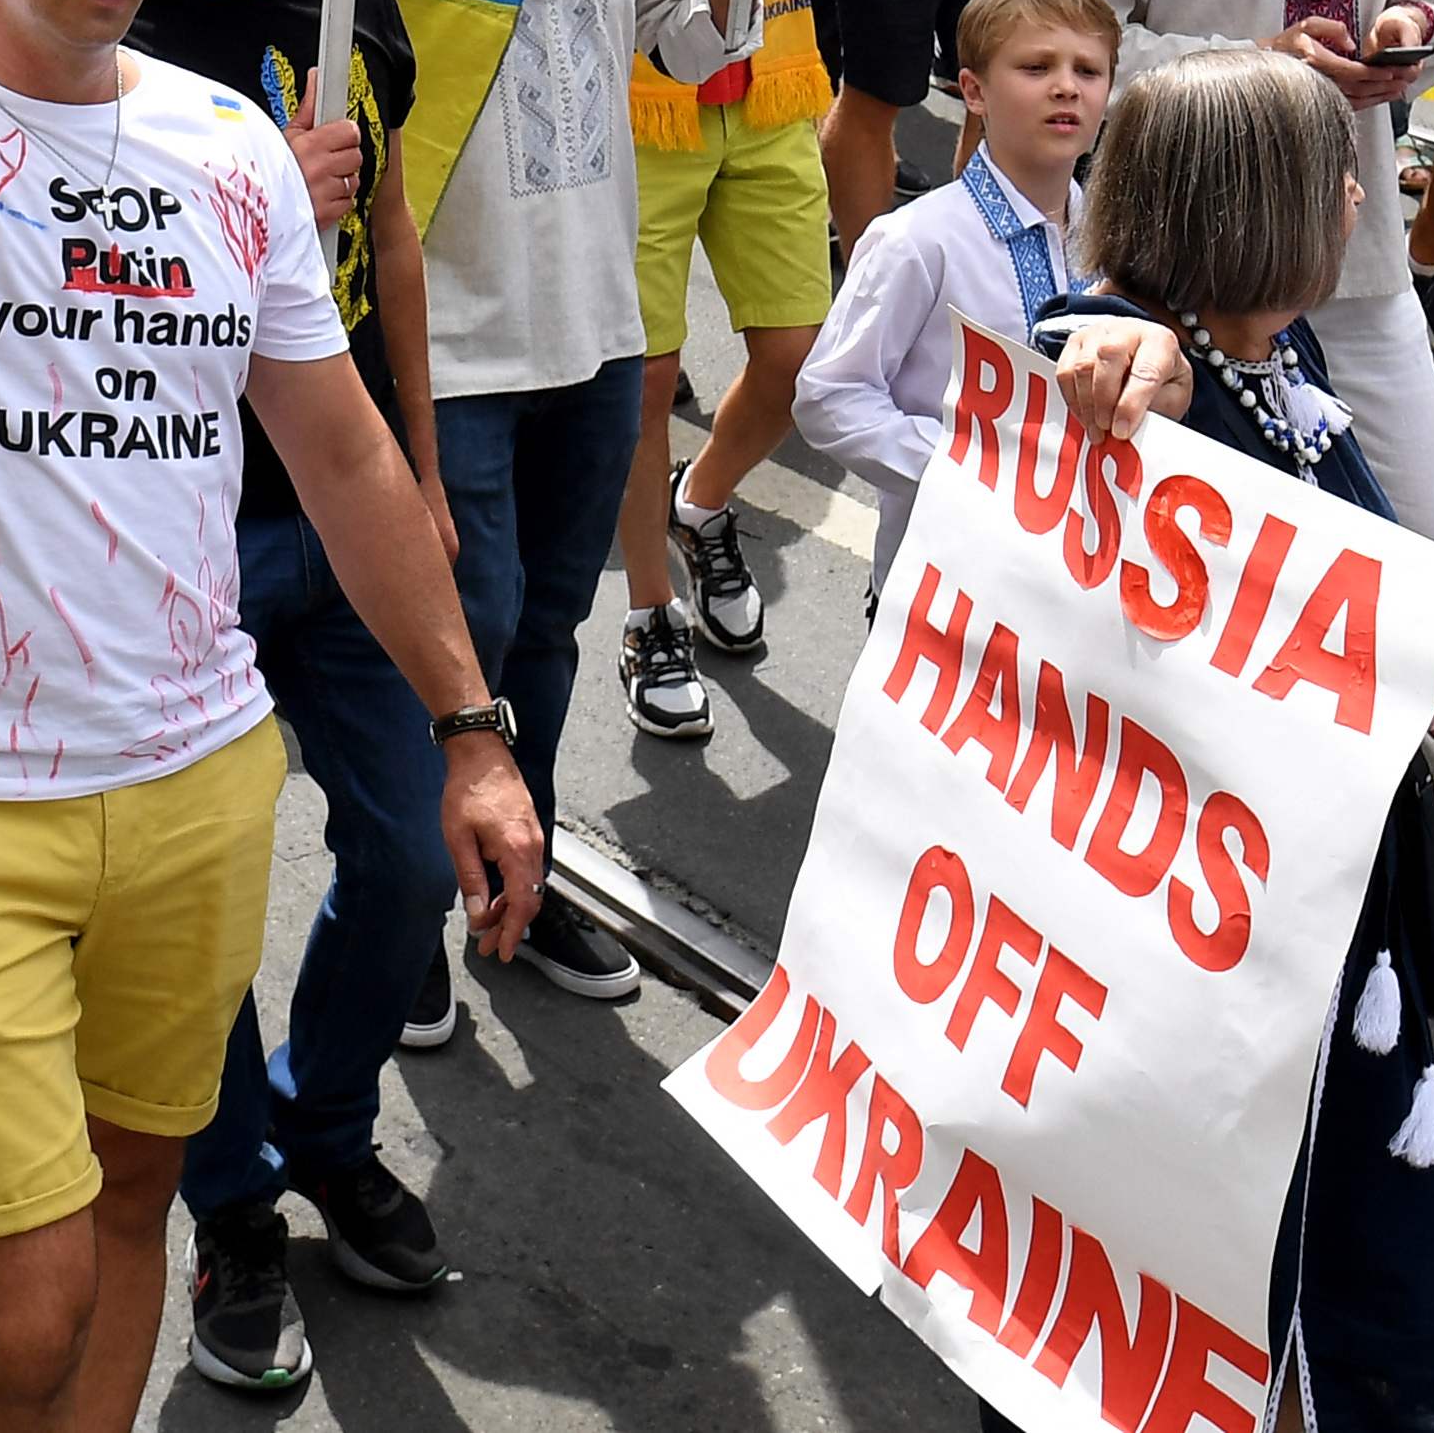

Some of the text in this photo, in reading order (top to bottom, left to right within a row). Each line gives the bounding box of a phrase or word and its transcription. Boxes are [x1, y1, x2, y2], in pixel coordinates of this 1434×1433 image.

[60, 237, 193, 289] Putin
[95, 366, 157, 401] on
[113, 299, 252, 348] hands
[949, 322, 1384, 736] RUSSIA
[880, 561, 1271, 973] HANDS
[892, 843, 1108, 1108] OFF
[703, 963, 1272, 1433] UKRAINE
